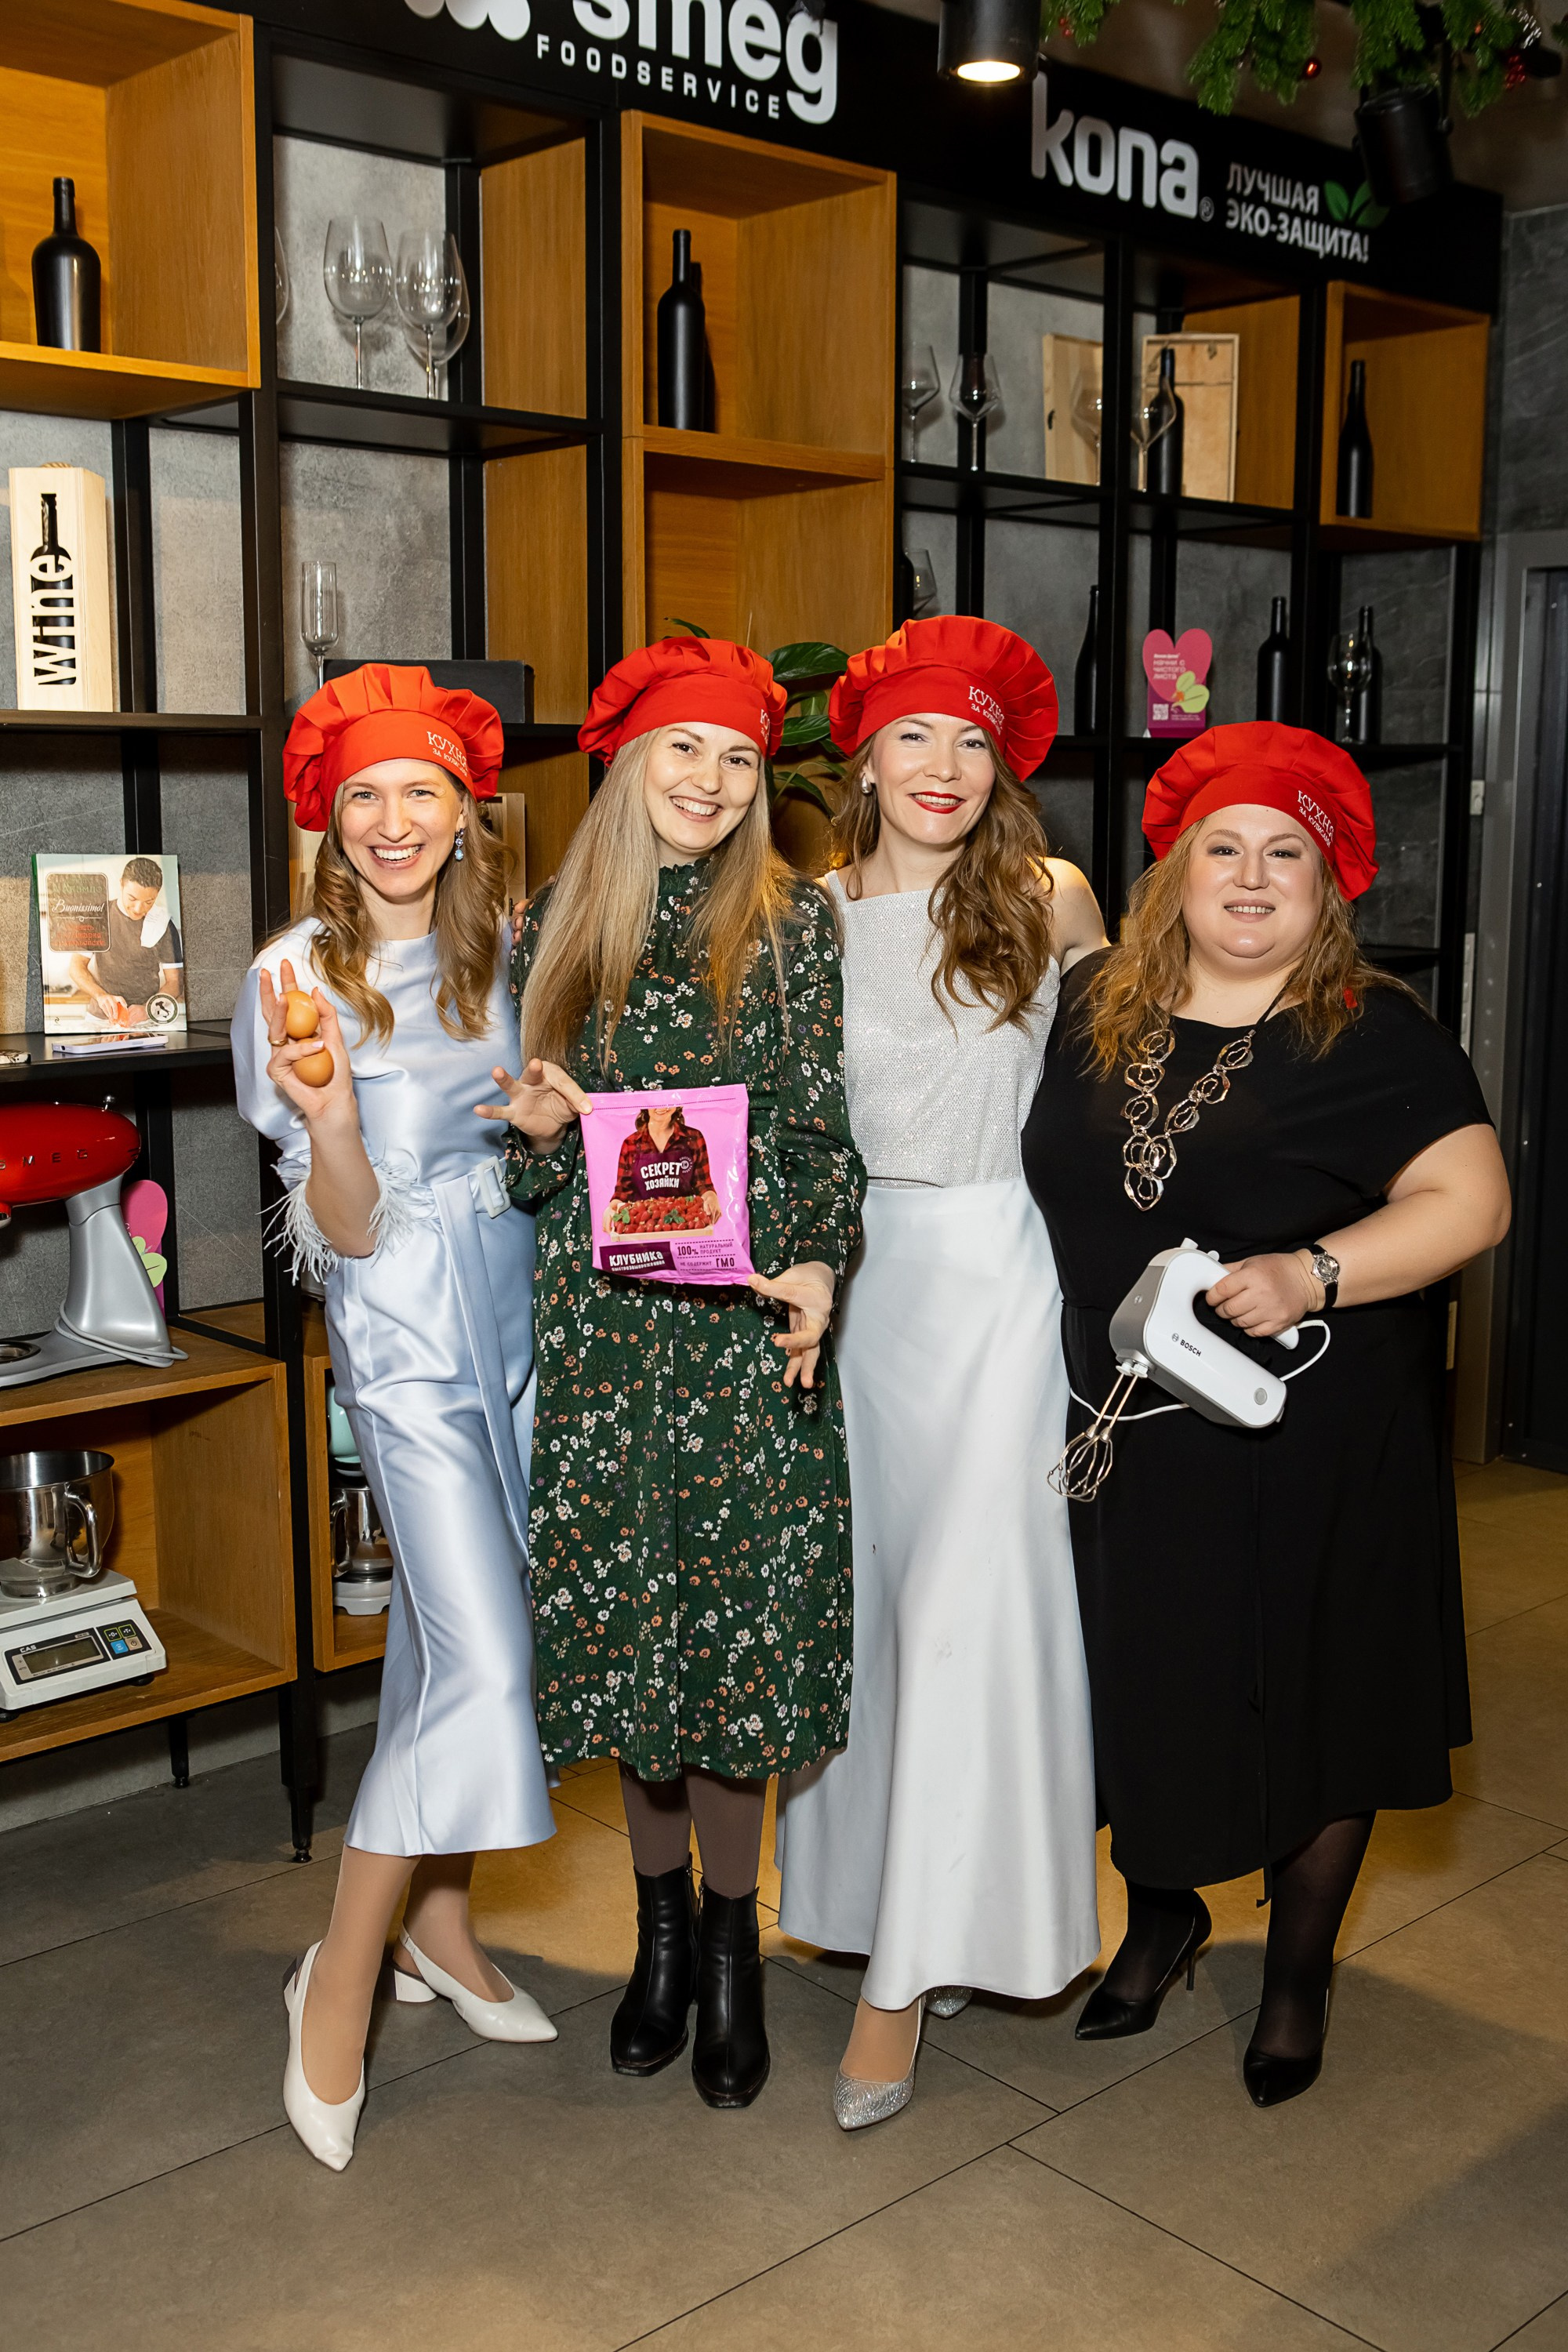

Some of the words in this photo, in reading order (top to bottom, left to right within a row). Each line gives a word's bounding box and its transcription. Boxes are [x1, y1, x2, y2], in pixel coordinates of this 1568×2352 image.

[537, 33, 780, 120] FOODSERVICE
[572, 0, 838, 125] smeg
[1030, 71, 1200, 220] kona
[1225, 162, 1319, 216] ЛУЧШАЯ
[1225, 198, 1370, 263] ЭКО-ЗАЩИТА!
[426, 731, 468, 771] КУХНЯ
[1298, 790, 1334, 842] КУХНЯ
[51, 898, 105, 913] Buonissimo!
[641, 1162, 681, 1178] СЕКРЕТ
[644, 1175, 680, 1191] ХОЗЯЙКИ
[677, 1246, 699, 1256] 100%
[716, 1258, 735, 1268] ГМО
[1181, 1339, 1202, 1356] BOSCH
[20, 1644, 37, 1653] CAS
